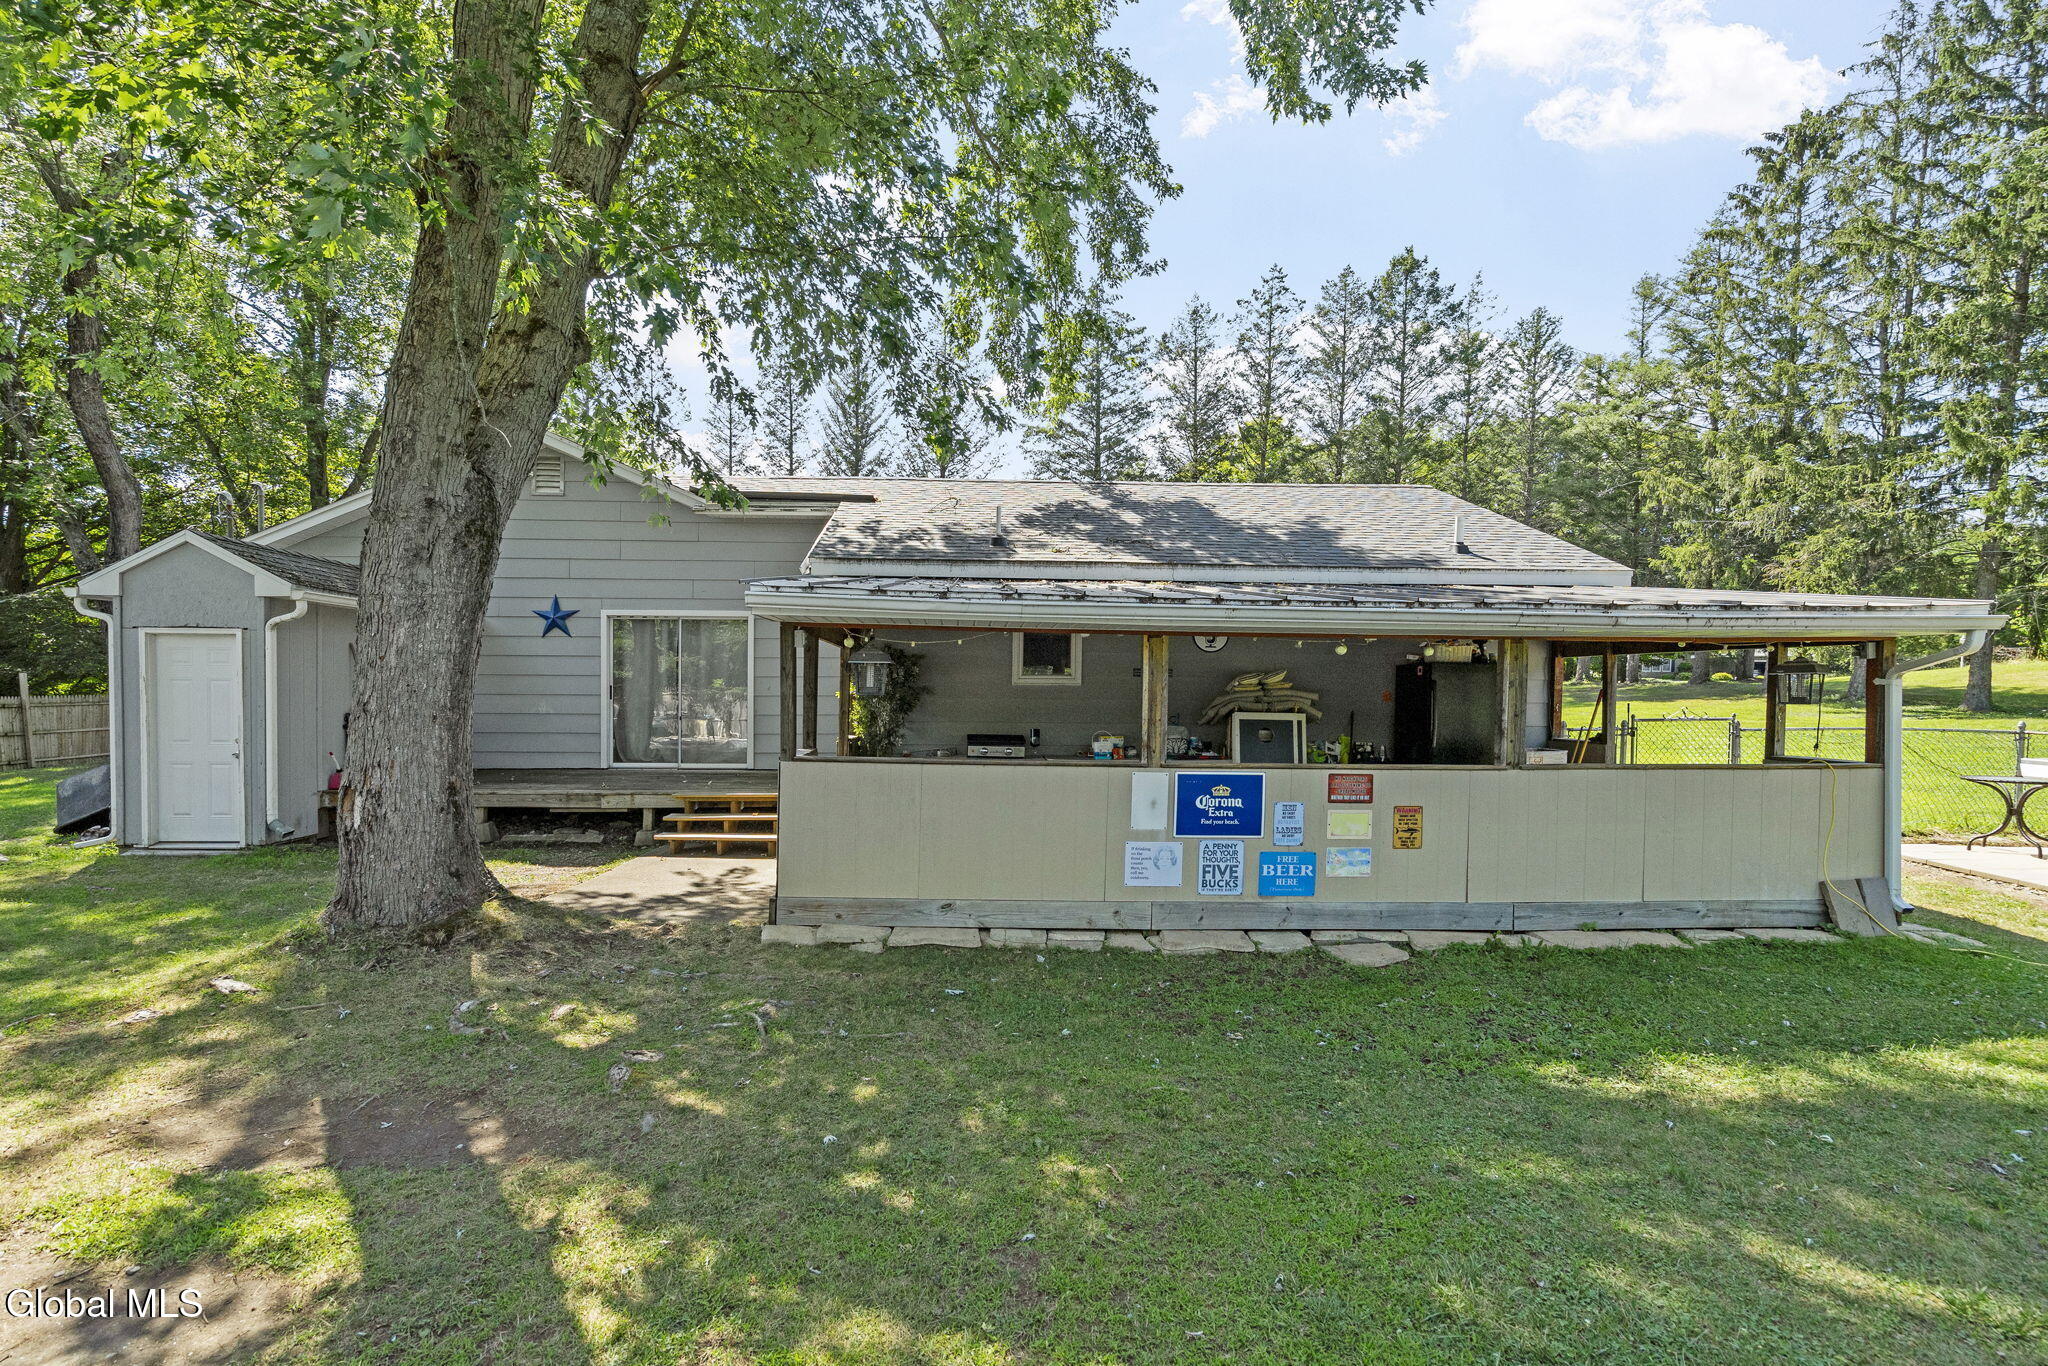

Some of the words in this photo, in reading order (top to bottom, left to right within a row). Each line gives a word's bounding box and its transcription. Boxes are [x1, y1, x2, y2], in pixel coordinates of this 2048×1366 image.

[1195, 794, 1244, 811] Corona
[1208, 807, 1234, 817] Extra
[1202, 849, 1218, 857] FOR
[1219, 849, 1239, 857] YOUR
[1202, 856, 1241, 864] THOUGHTS,
[1277, 855, 1299, 863] FREE
[1202, 864, 1239, 880] FIVE
[1262, 864, 1314, 876] BEER
[1201, 879, 1239, 888] BUCKS
[1275, 878, 1299, 886] HERE
